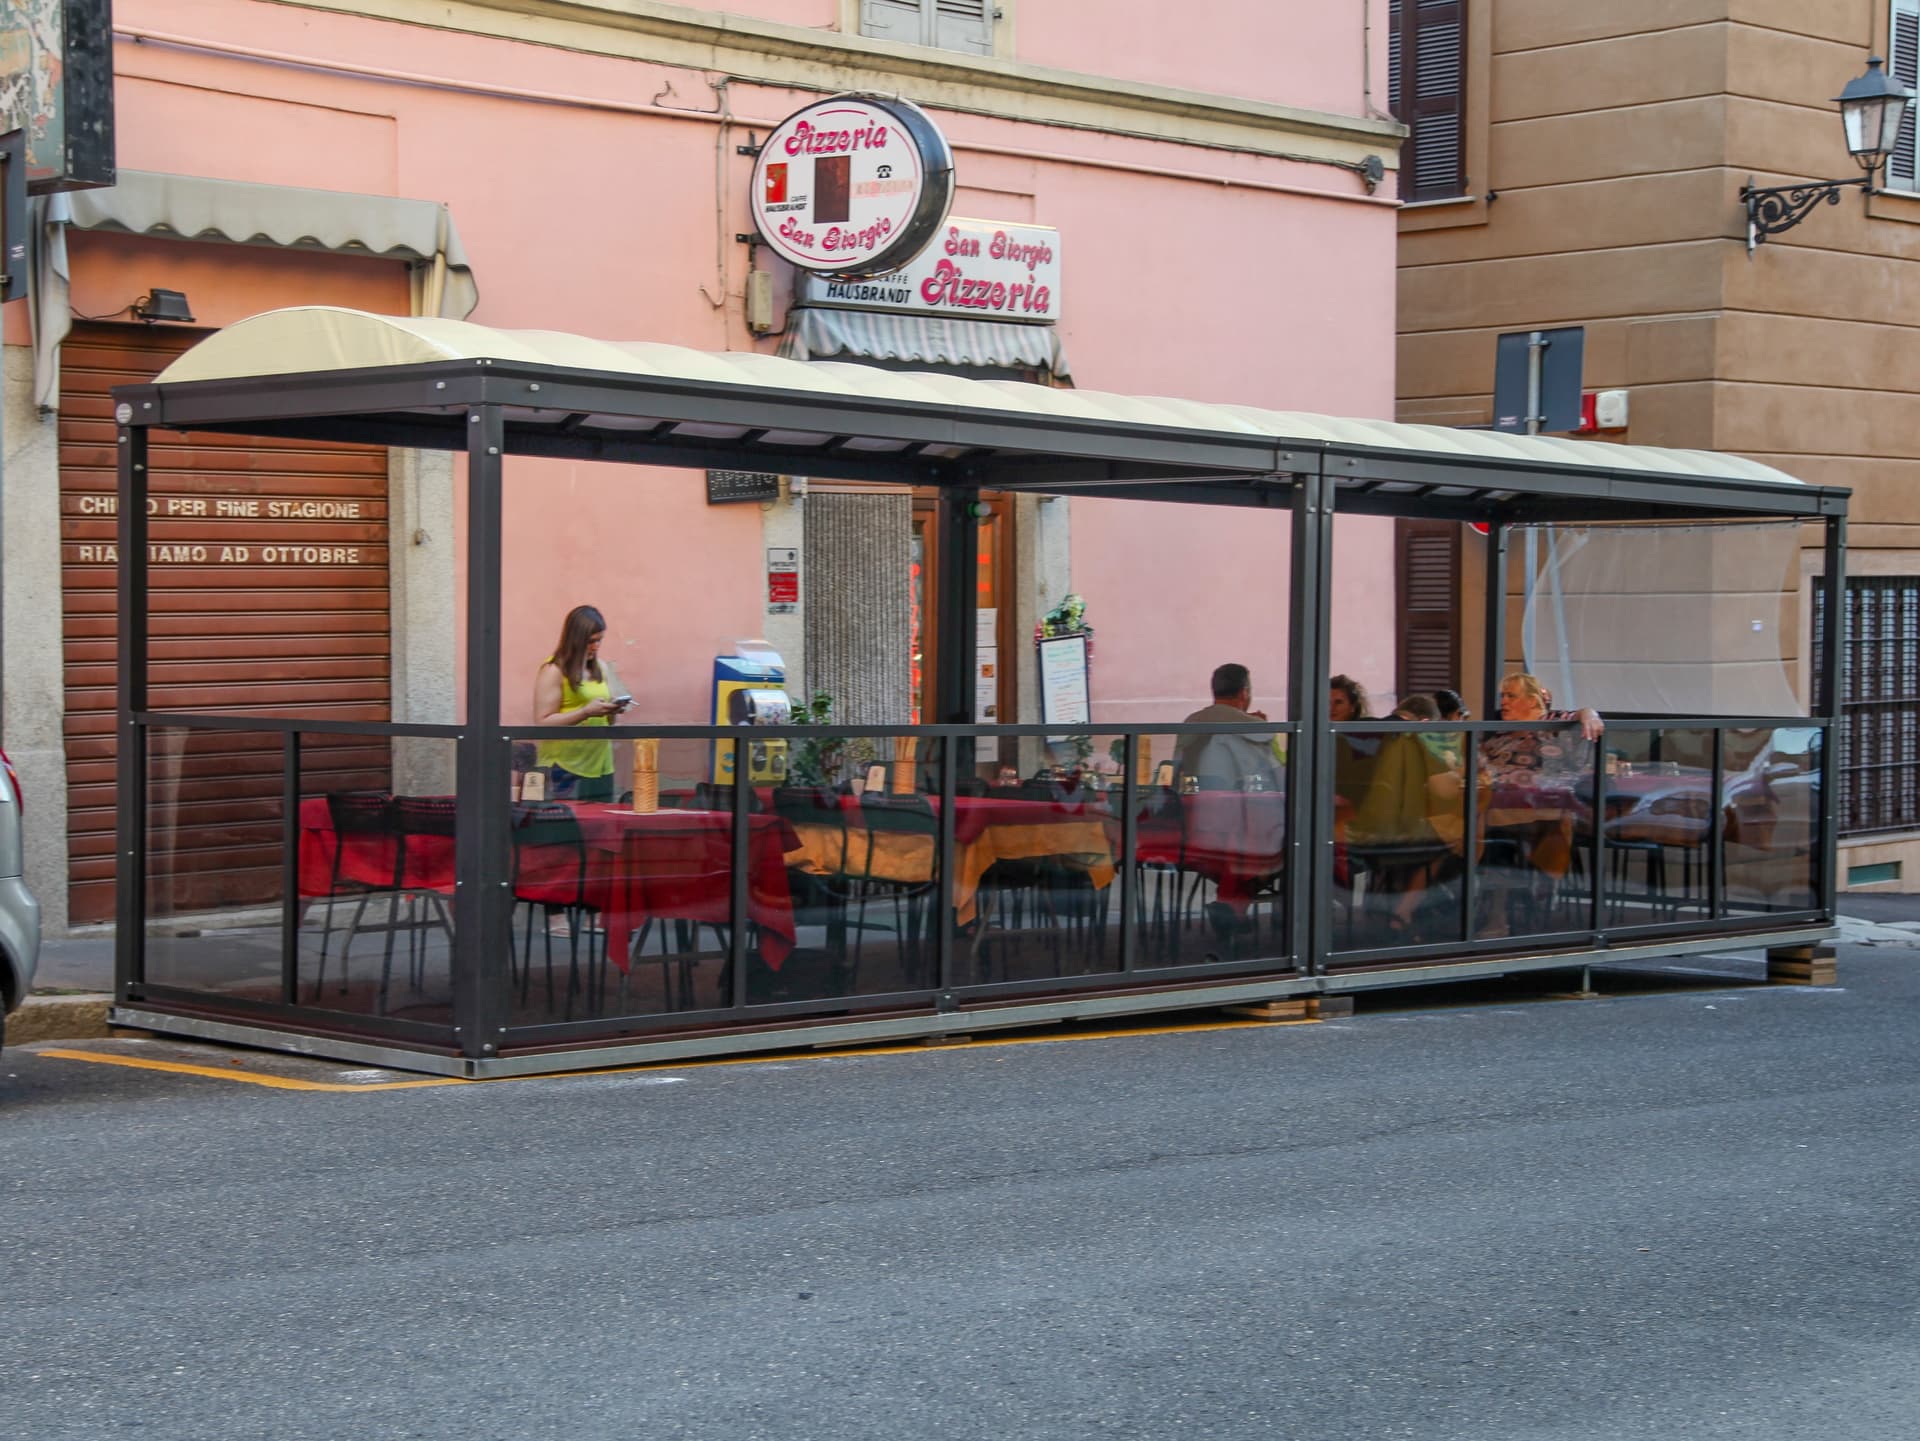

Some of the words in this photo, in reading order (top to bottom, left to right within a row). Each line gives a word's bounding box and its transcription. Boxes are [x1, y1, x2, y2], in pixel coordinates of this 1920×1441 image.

[785, 119, 888, 156] Pizzeria
[779, 217, 815, 249] San
[821, 217, 891, 251] Giorgio
[944, 226, 981, 258] San
[989, 230, 1053, 271] Giorgio
[827, 283, 912, 304] HAUSBRANDT
[920, 258, 1051, 314] Pizzeria
[79, 496, 158, 515] CHIO
[167, 499, 207, 516] PER
[216, 501, 260, 517] FINE
[268, 502, 360, 519] STAGIONE
[79, 546, 208, 563] RIAIAMO
[220, 547, 250, 563] AD
[262, 548, 359, 564] OTTOBRE
